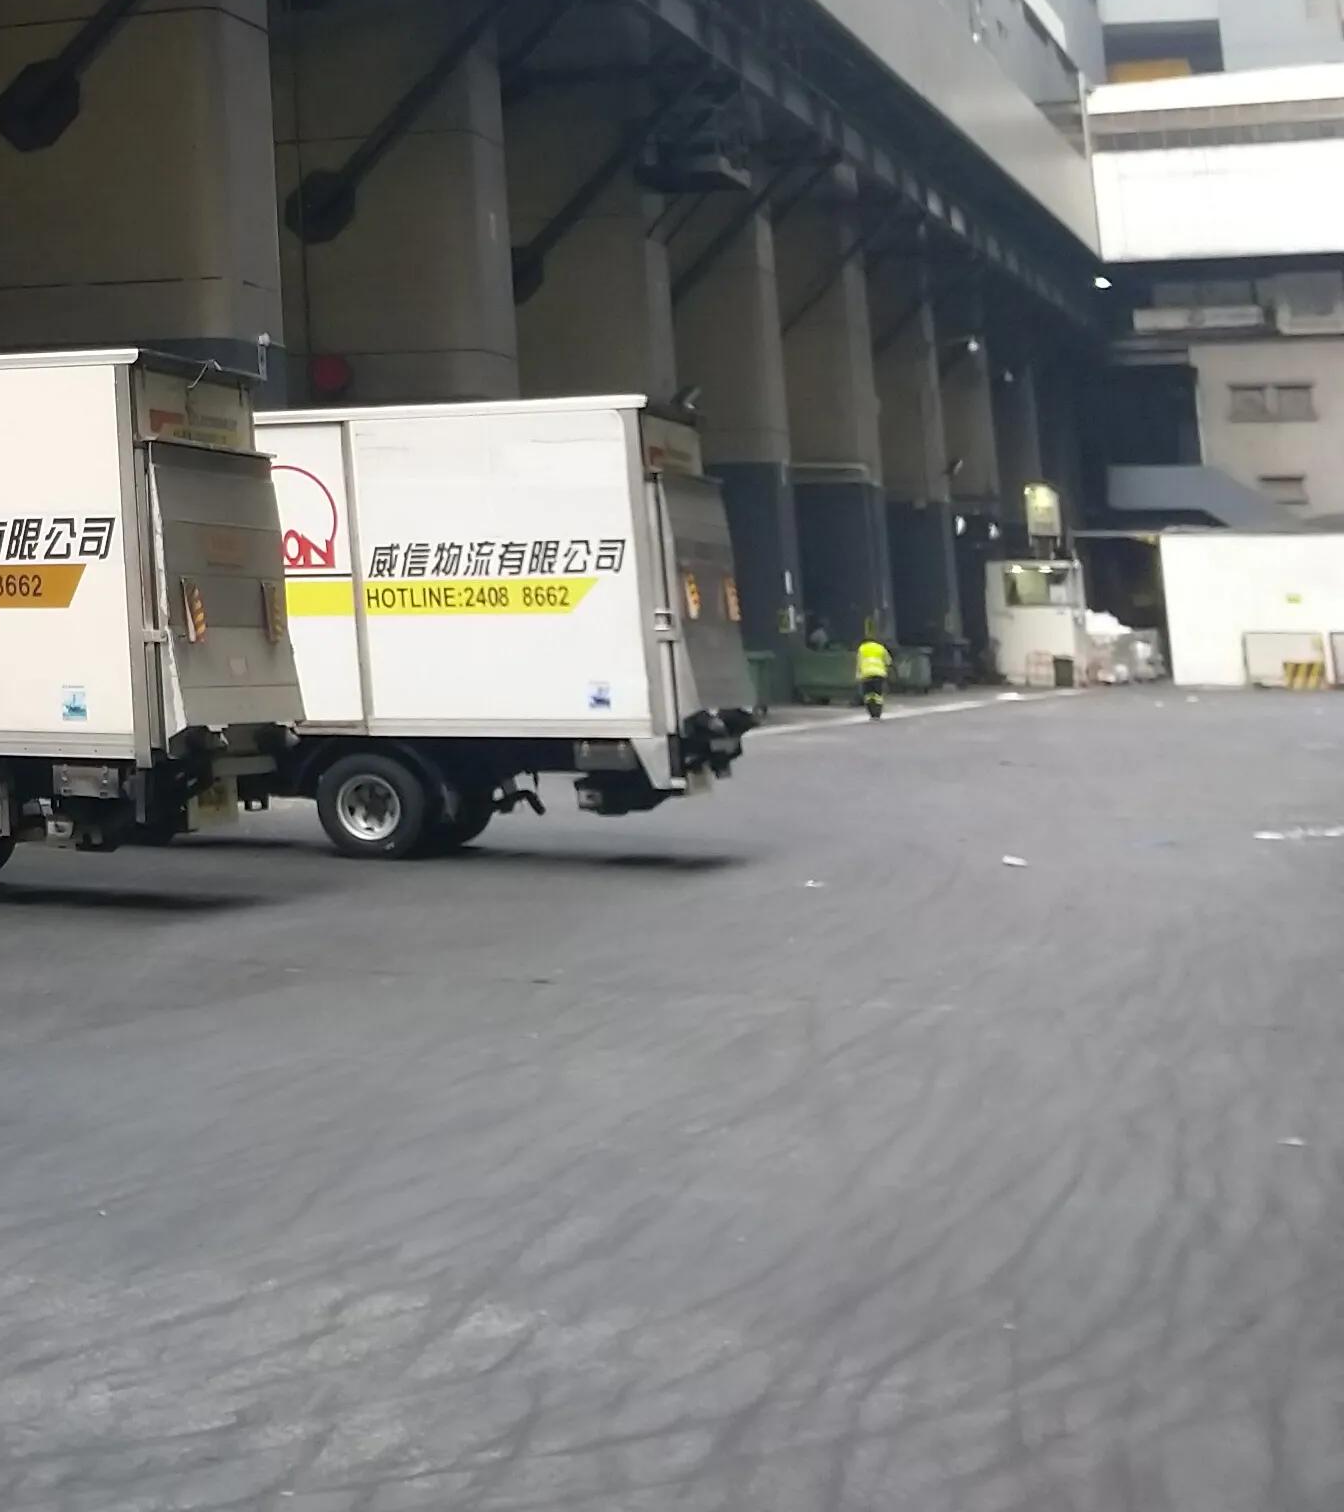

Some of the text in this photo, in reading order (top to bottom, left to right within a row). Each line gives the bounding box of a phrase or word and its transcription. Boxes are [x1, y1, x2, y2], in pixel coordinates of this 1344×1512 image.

[368, 539, 626, 578] 威信物流有限公司
[523, 586, 571, 607] 8662
